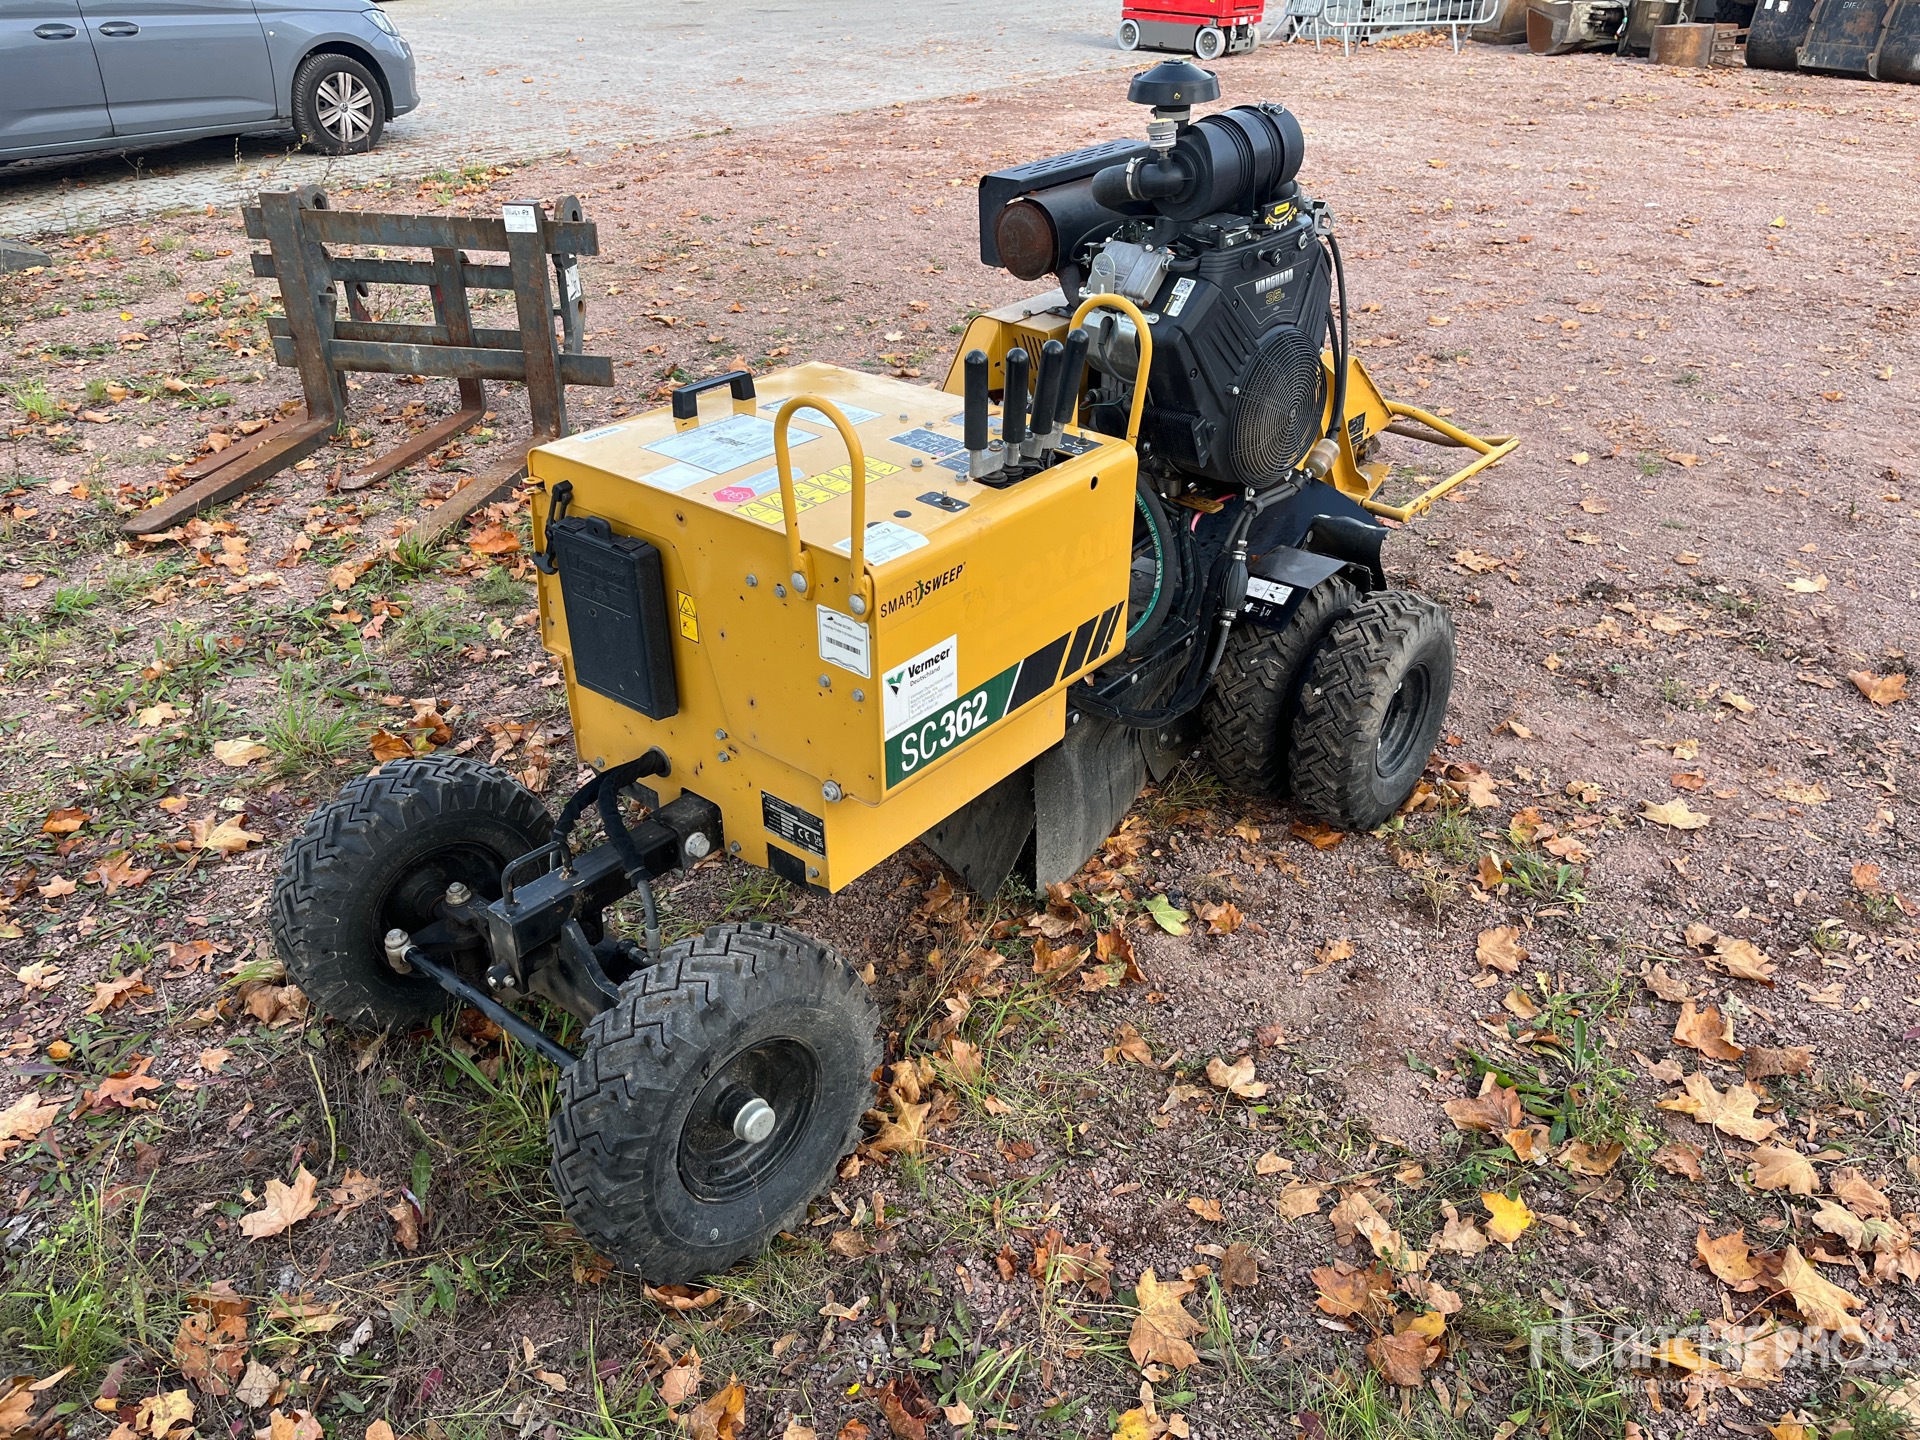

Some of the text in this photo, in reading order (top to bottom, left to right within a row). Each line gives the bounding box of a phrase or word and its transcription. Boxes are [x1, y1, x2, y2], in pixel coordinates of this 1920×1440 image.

[1255, 268, 1294, 294] VANGUARD
[1265, 288, 1282, 305] 35
[880, 564, 963, 618] SMART SWEEP
[907, 648, 950, 679] Vermeer
[910, 665, 941, 687] Deutschland
